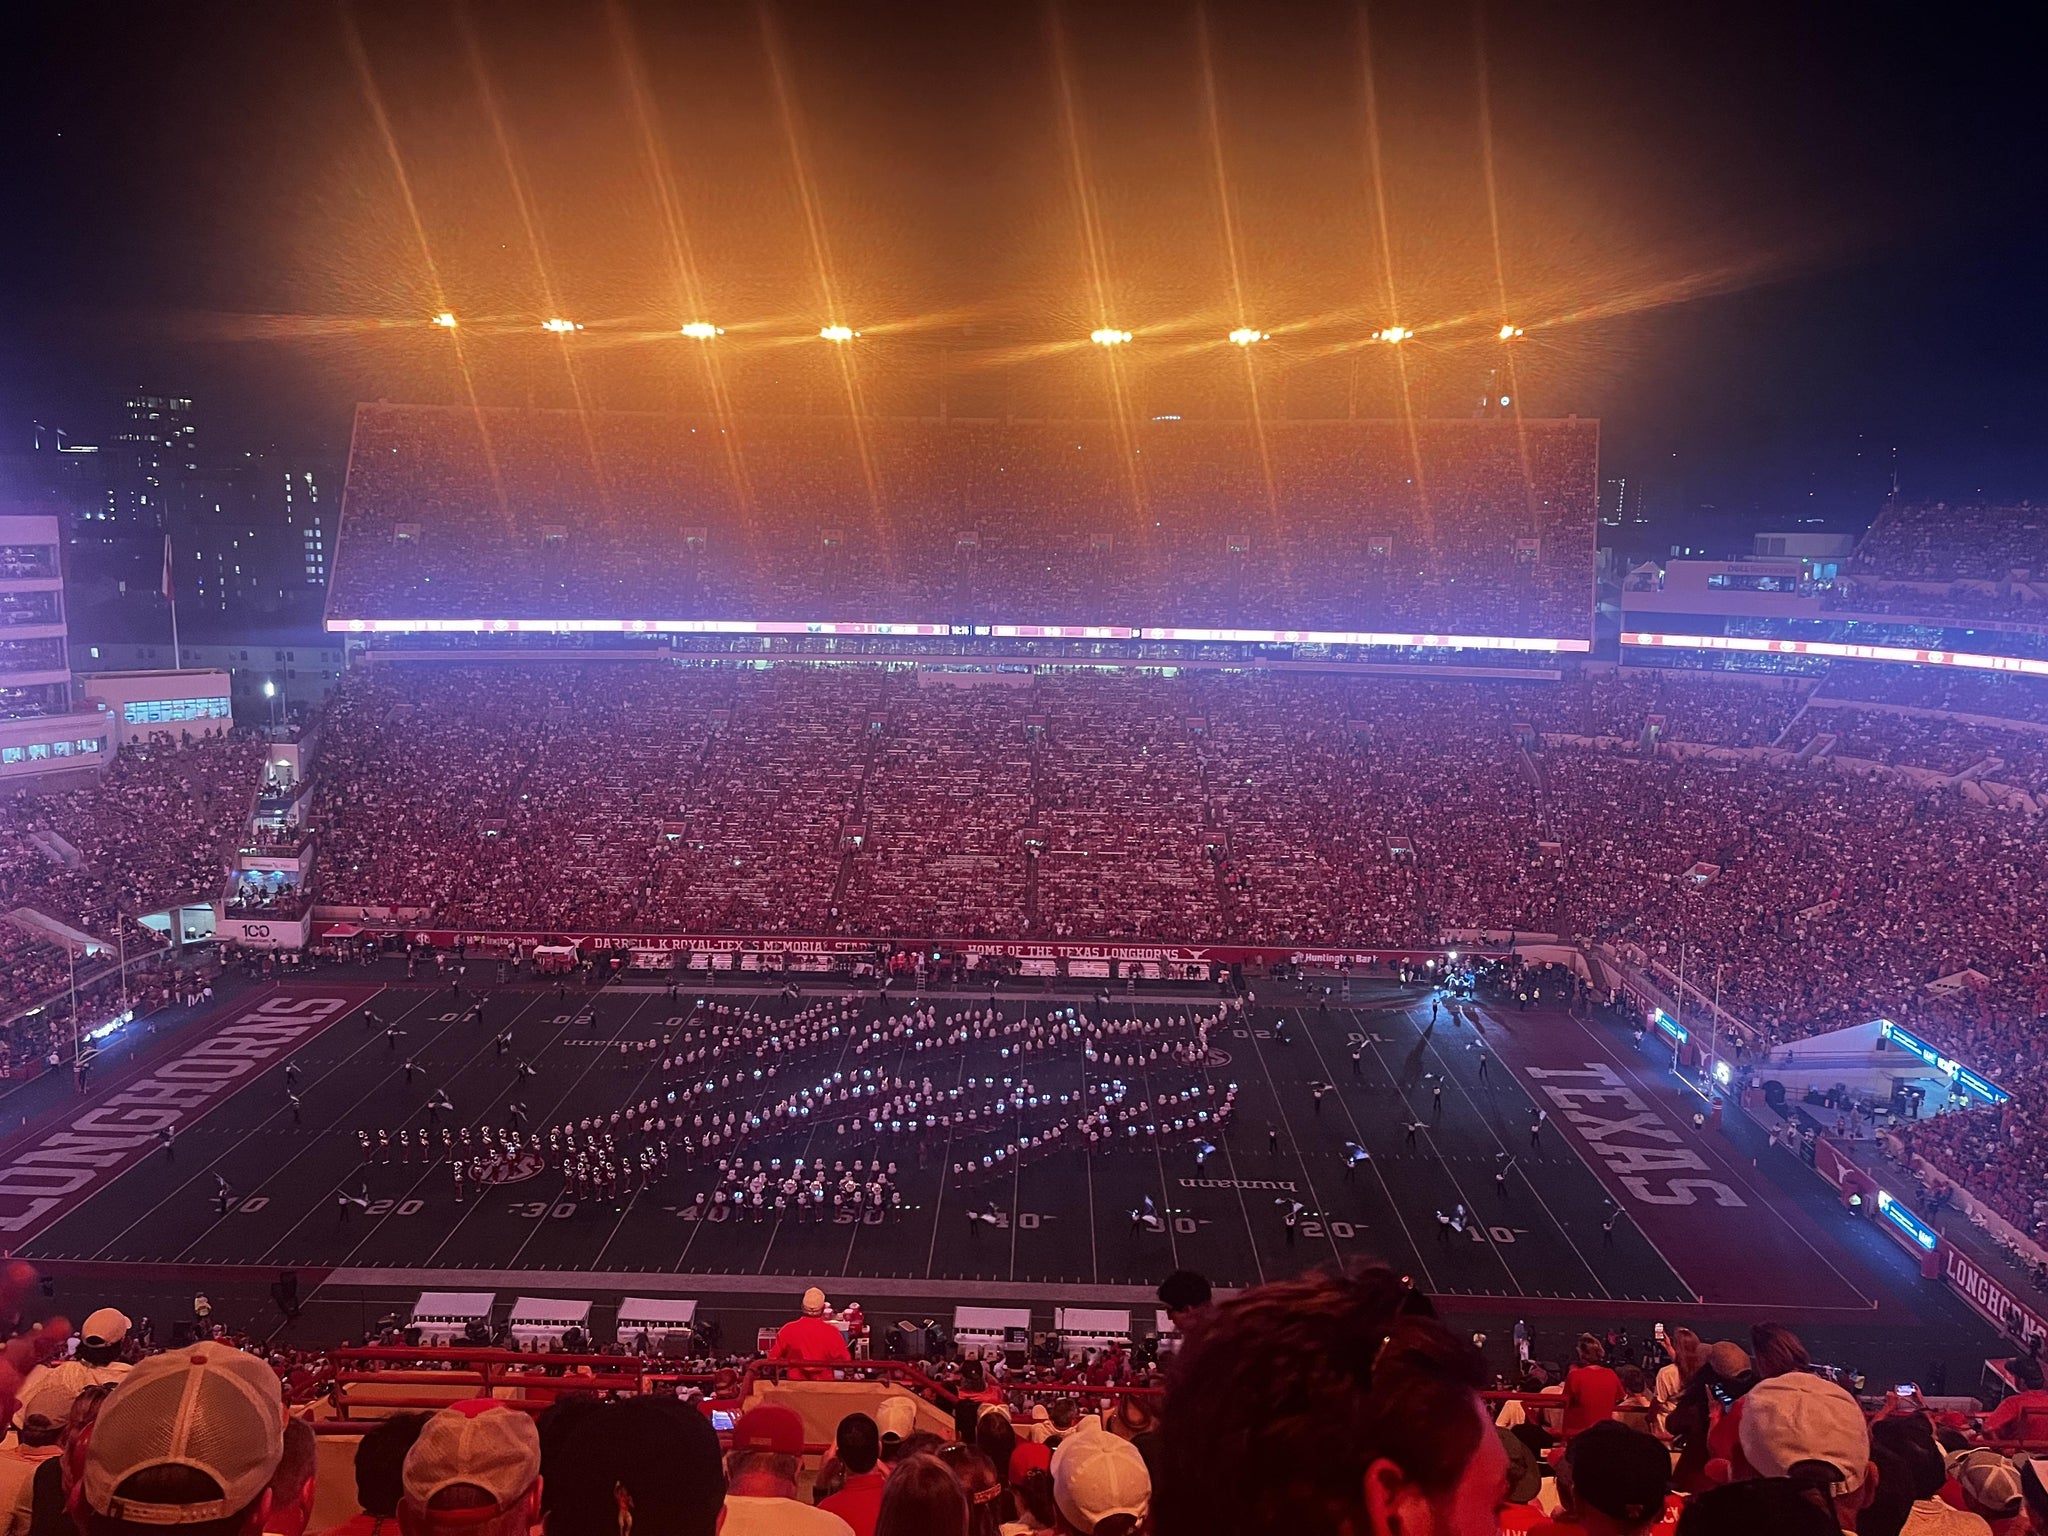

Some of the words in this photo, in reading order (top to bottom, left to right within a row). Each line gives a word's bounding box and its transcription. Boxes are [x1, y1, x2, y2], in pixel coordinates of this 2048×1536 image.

[242, 924, 270, 937] 100
[594, 938, 654, 949] DARRELL
[659, 939, 668, 949] K
[672, 939, 760, 950] ROYAL-TEXS
[763, 940, 828, 951] MEMORIA
[968, 945, 1003, 955] HOME
[1007, 946, 1023, 955] OF
[1027, 946, 1054, 956] THE
[1058, 947, 1100, 957] TEXAS
[1103, 948, 1179, 959] LONGHORNS
[1305, 953, 1355, 965] Huntingtn
[0, 998, 347, 1232] LONGHORNS
[1524, 1063, 1748, 1207] TEXAS
[1178, 1178, 1298, 1192] humann
[364, 1199, 424, 1215] 20
[521, 1202, 577, 1218] 30
[1300, 1221, 1355, 1238] 20
[1466, 1226, 1516, 1243] 10
